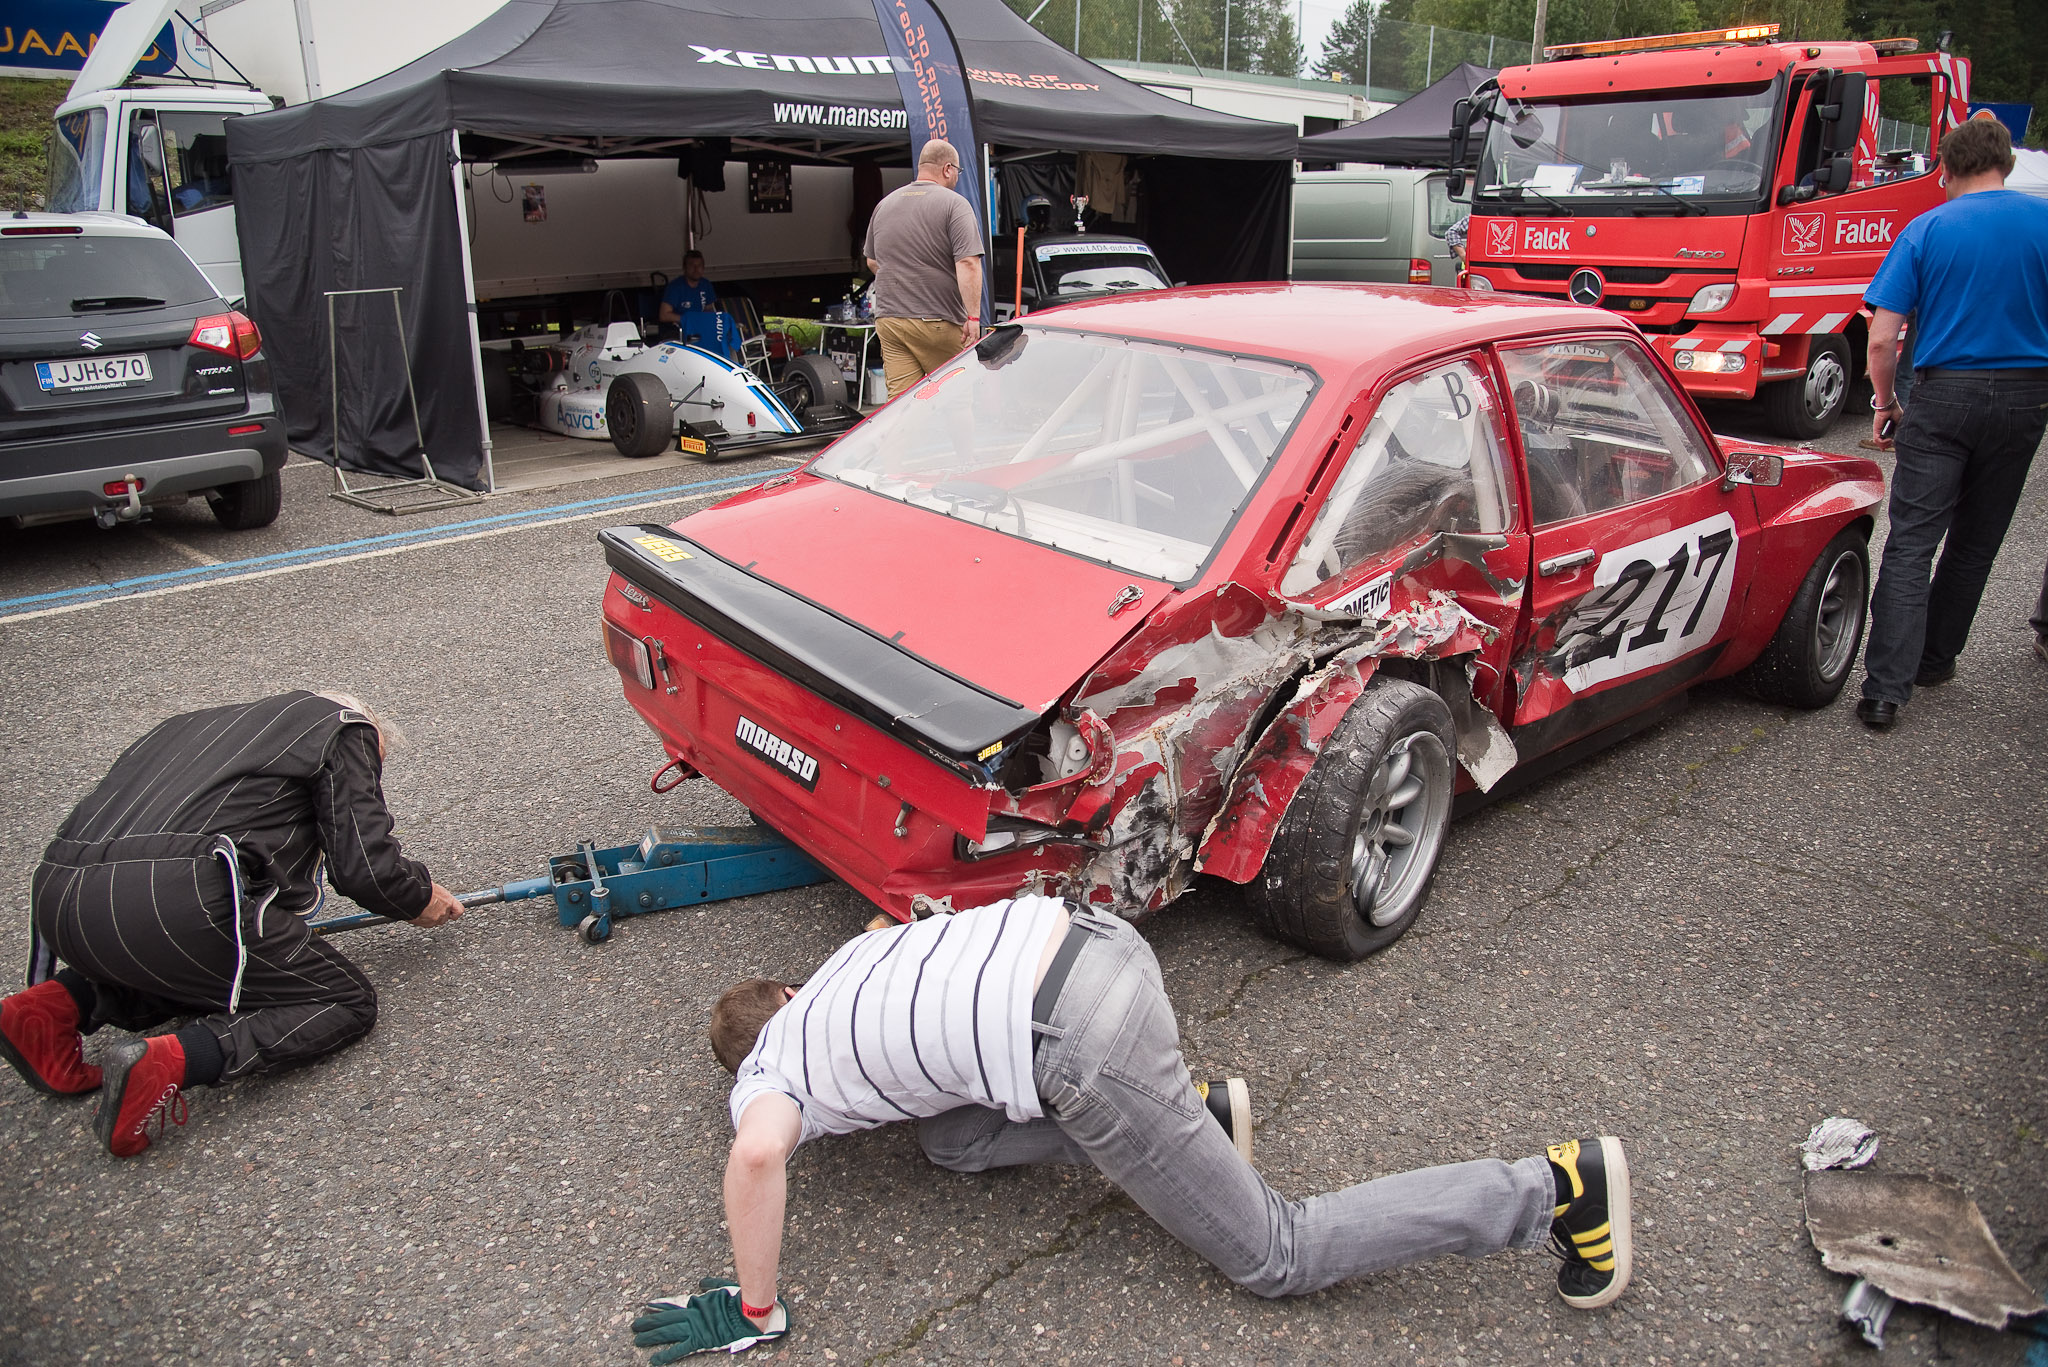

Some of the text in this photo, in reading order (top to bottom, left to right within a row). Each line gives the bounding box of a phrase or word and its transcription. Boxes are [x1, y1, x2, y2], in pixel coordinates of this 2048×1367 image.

[1029, 74, 1060, 83] OF
[1524, 227, 1571, 251] Falck
[1835, 218, 1893, 245] Falck
[1777, 266, 1815, 276] 1224
[41, 377, 54, 385] FIN
[58, 358, 145, 384] JJH-670
[195, 365, 233, 376] VITARA
[1442, 371, 1472, 420] B
[557, 402, 596, 431] Aava
[632, 535, 695, 563] JEGS
[1343, 580, 1389, 618] OMETIC
[1570, 527, 1734, 669] 217
[735, 715, 818, 782] MOROSO
[977, 740, 1003, 762] JEGS
